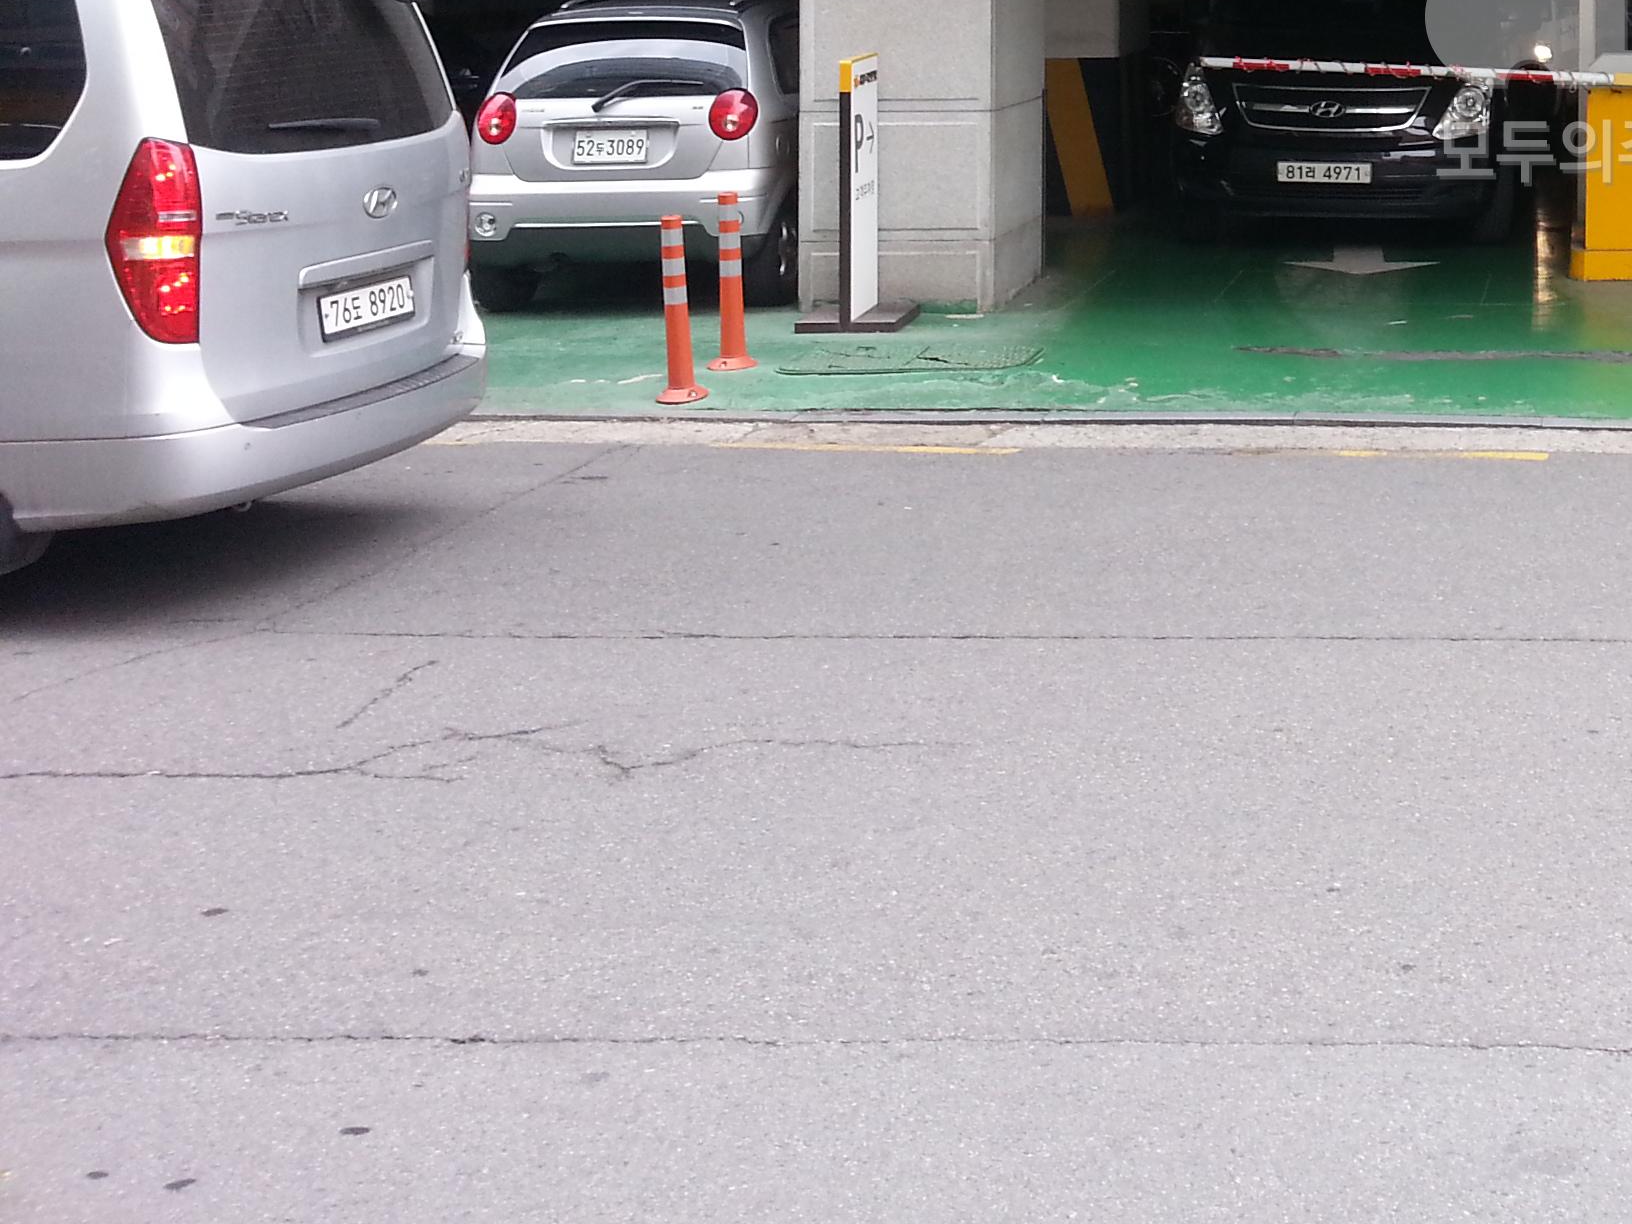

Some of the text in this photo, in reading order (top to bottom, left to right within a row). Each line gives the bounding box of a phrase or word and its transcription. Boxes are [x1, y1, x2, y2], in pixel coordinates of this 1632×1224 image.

[854, 113, 864, 173] P
[1322, 165, 1361, 181] 4971
[329, 283, 406, 326] 76도 8920
